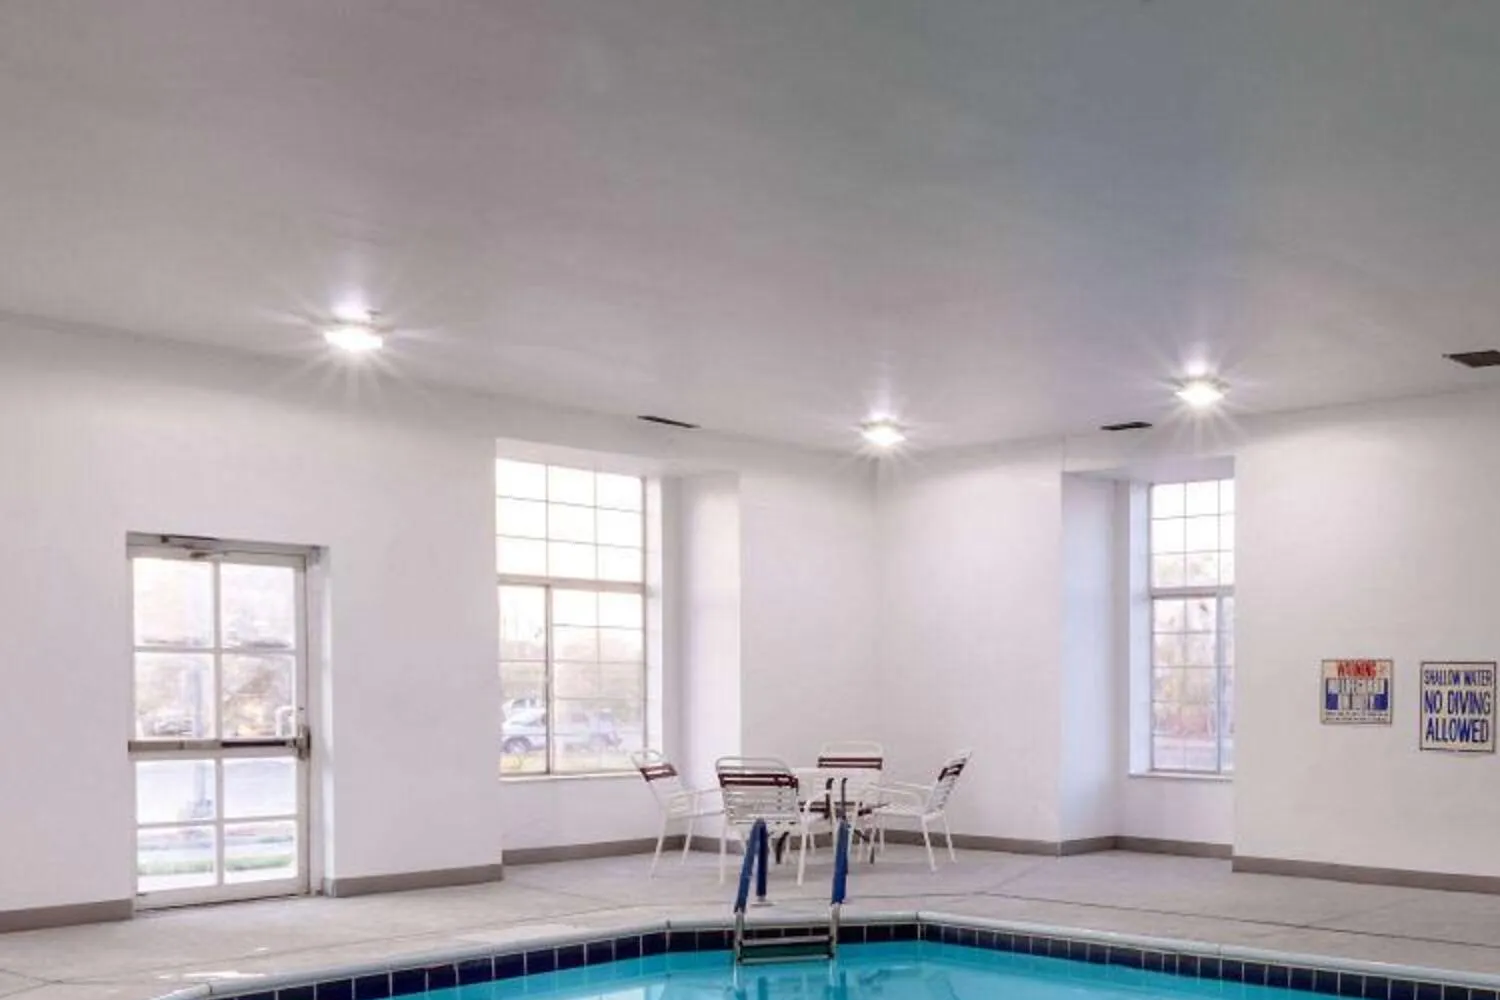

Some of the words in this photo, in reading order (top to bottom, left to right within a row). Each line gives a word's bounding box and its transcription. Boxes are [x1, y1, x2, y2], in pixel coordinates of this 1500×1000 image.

[1424, 669, 1461, 686] SHALLOW
[1463, 669, 1493, 687] WATER
[1424, 690, 1443, 714] NO
[1447, 690, 1491, 715] DIVING
[1425, 717, 1489, 743] ALLOWED
